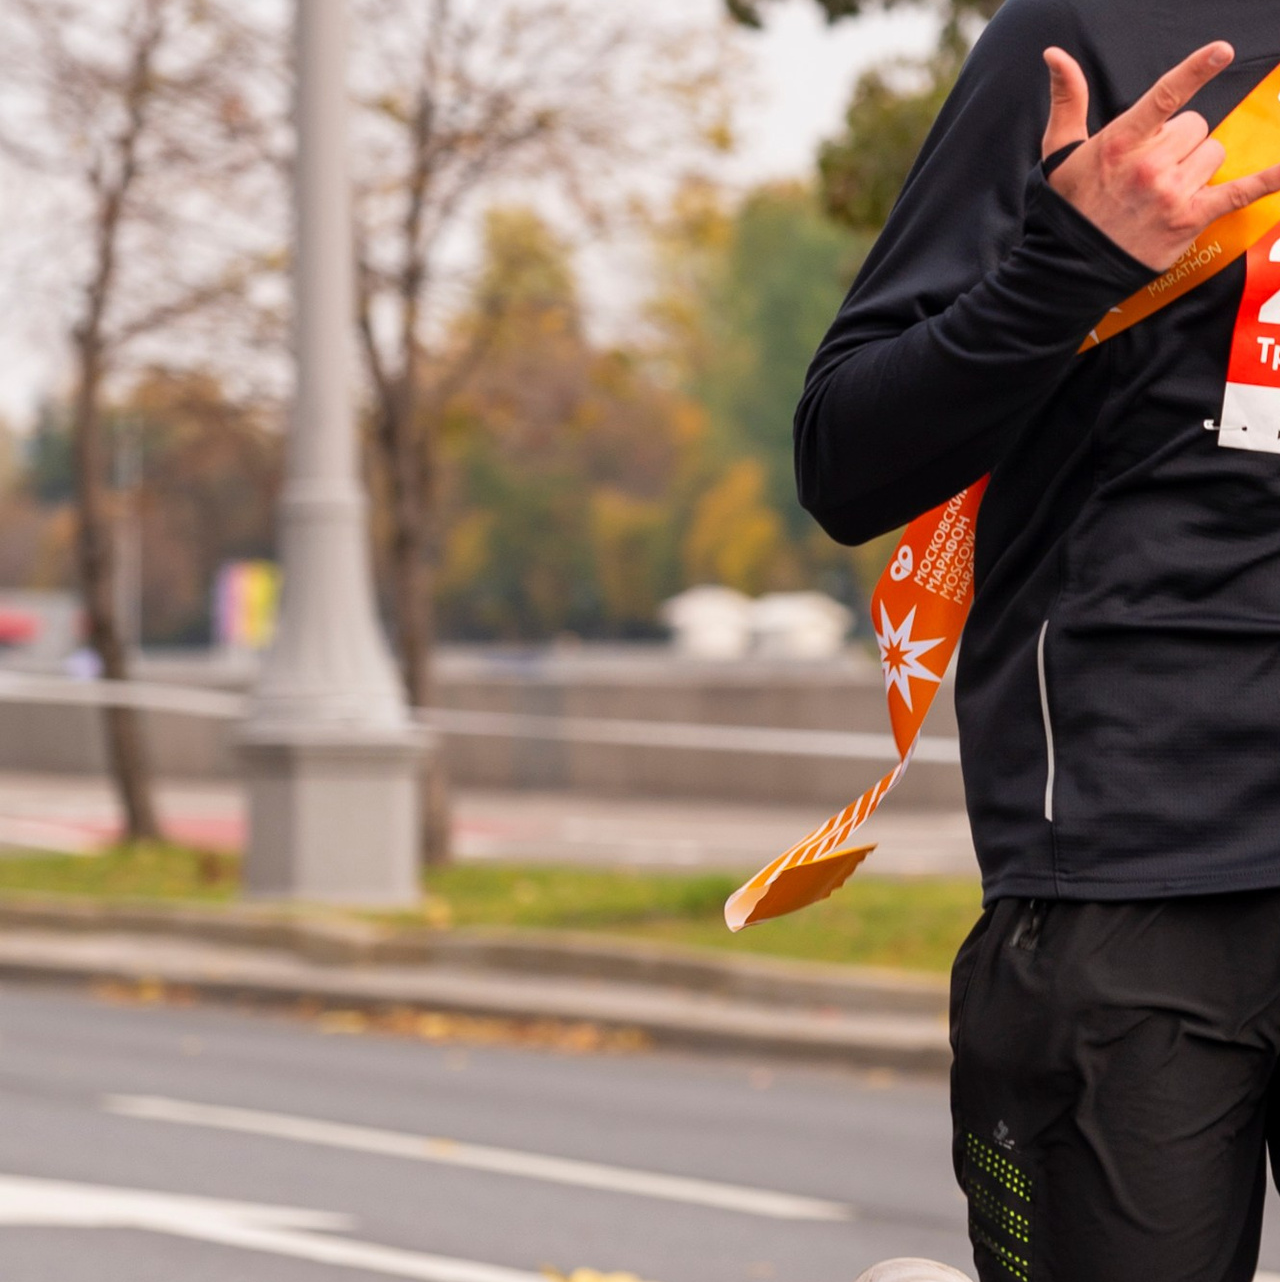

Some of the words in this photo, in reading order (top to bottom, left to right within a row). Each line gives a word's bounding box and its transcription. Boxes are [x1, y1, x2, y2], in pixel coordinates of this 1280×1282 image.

[1147, 241, 1222, 297] MARATHON
[913, 489, 968, 586] МОСКОВСКИ
[925, 515, 970, 593] МАРАФОН
[939, 529, 975, 600] MOSCOW
